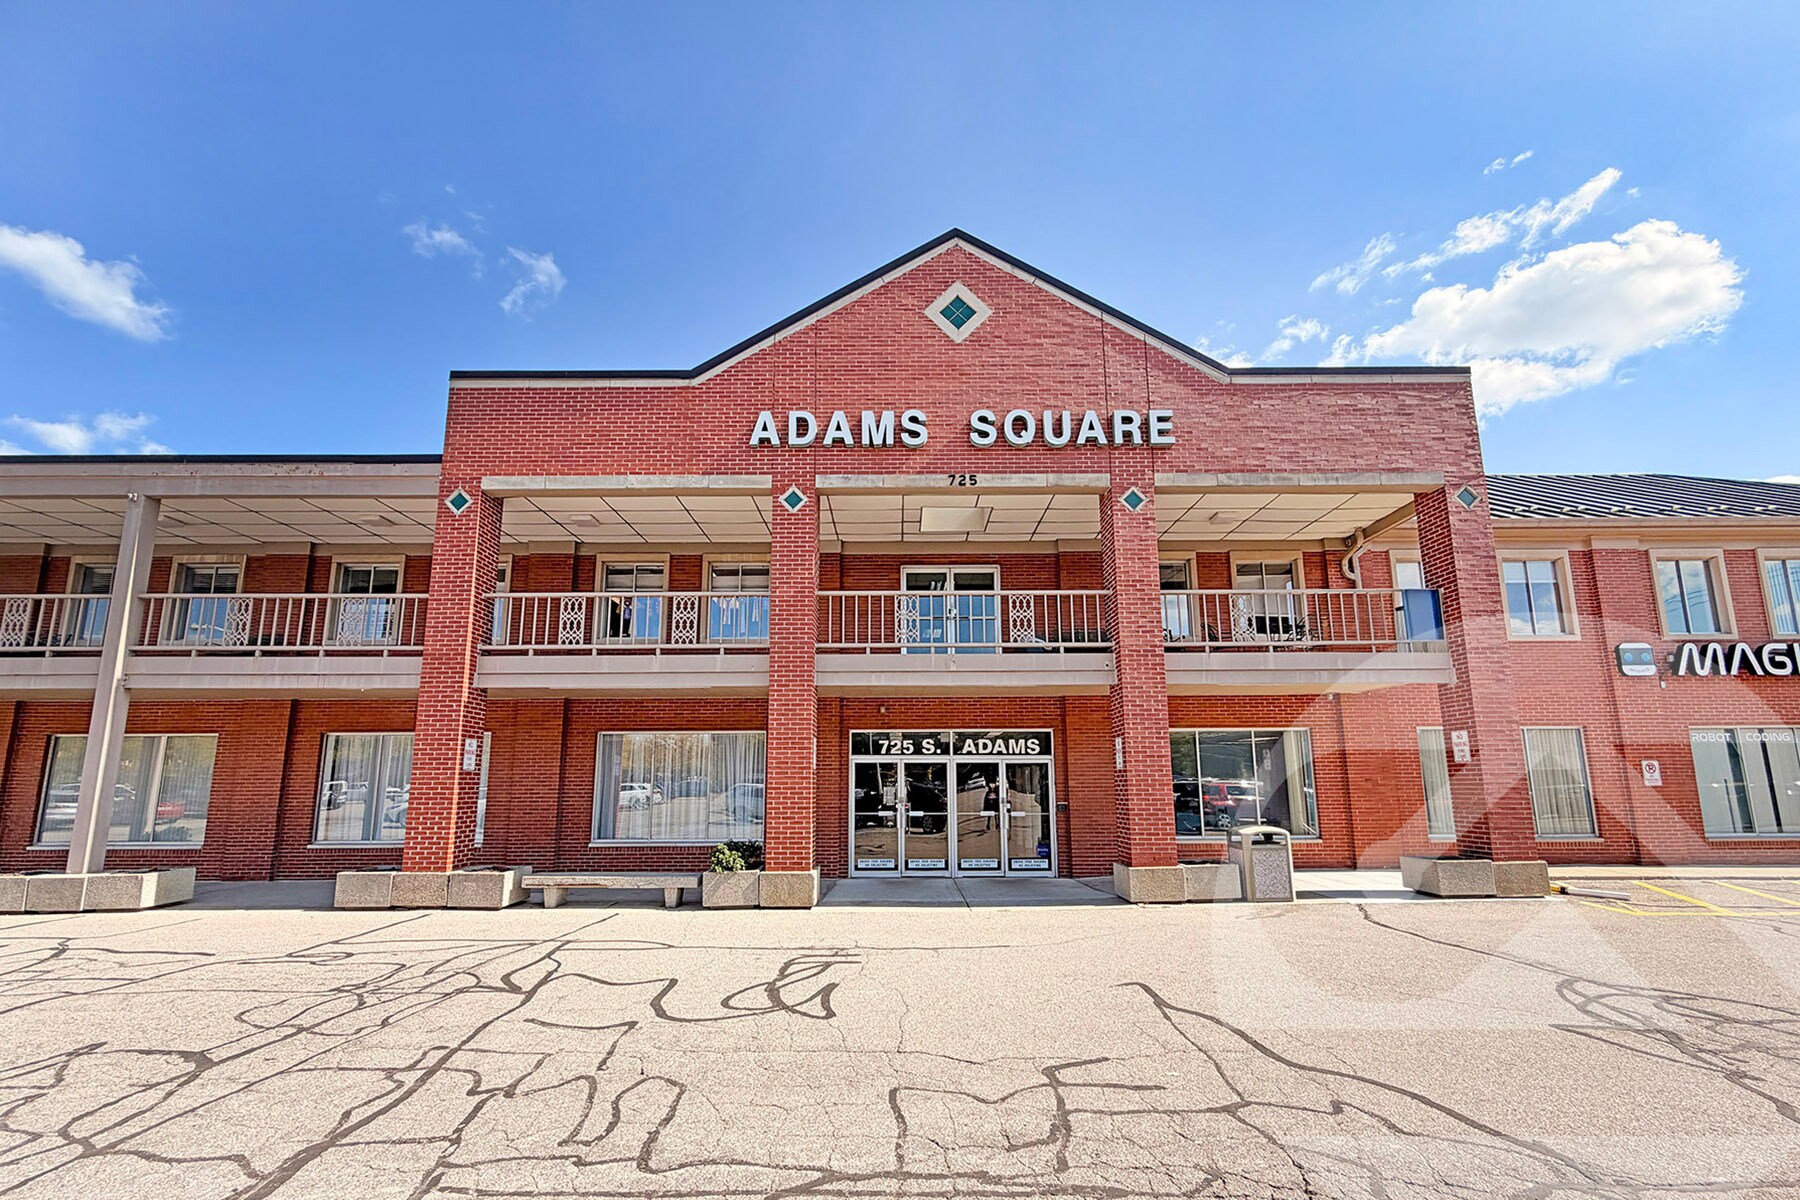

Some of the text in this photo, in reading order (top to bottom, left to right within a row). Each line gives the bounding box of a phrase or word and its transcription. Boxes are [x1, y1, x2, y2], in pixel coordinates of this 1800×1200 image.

[749, 409, 1177, 448] ADAMS SQUARE
[948, 474, 978, 486] 725
[1691, 732, 1790, 742] ROBOT CODING
[878, 739, 1040, 754] 725 S. ADAMS
